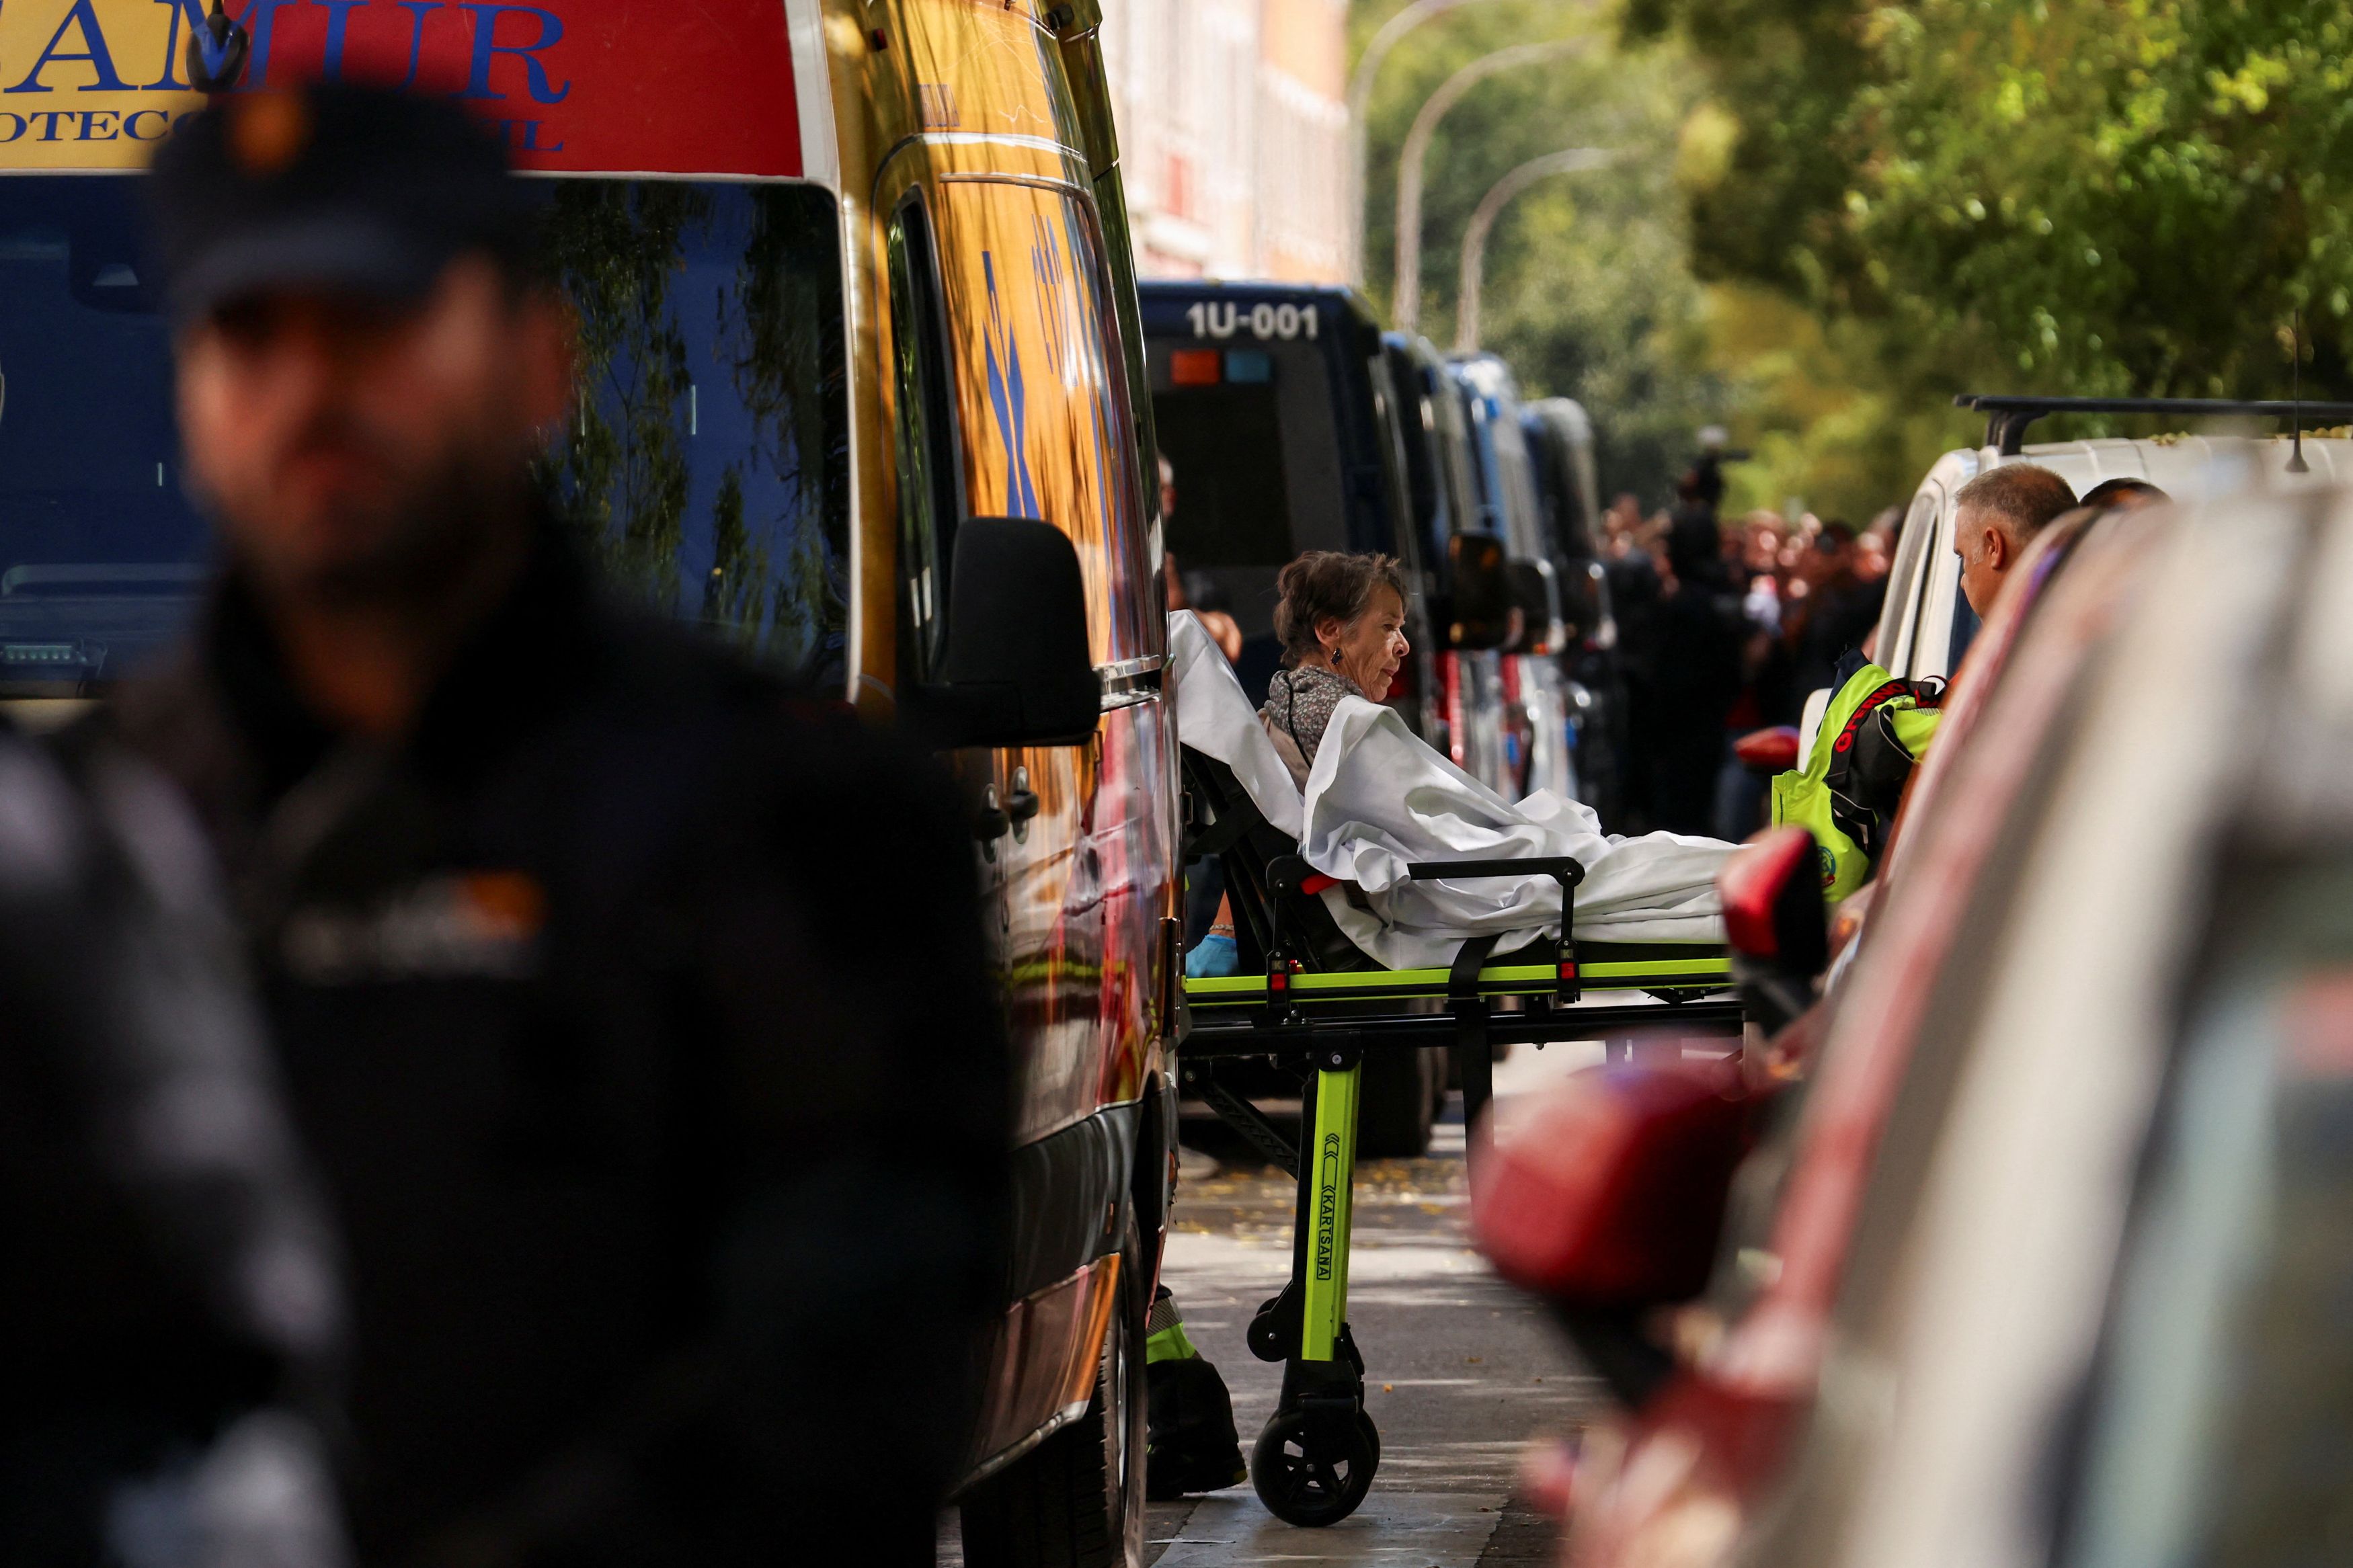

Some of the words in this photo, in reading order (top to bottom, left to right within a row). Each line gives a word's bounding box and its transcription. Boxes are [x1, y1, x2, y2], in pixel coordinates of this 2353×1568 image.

[0, 0, 571, 104] AMUR
[1185, 301, 1318, 340] 1U-001
[1318, 1194, 1333, 1276] KARTSANA
